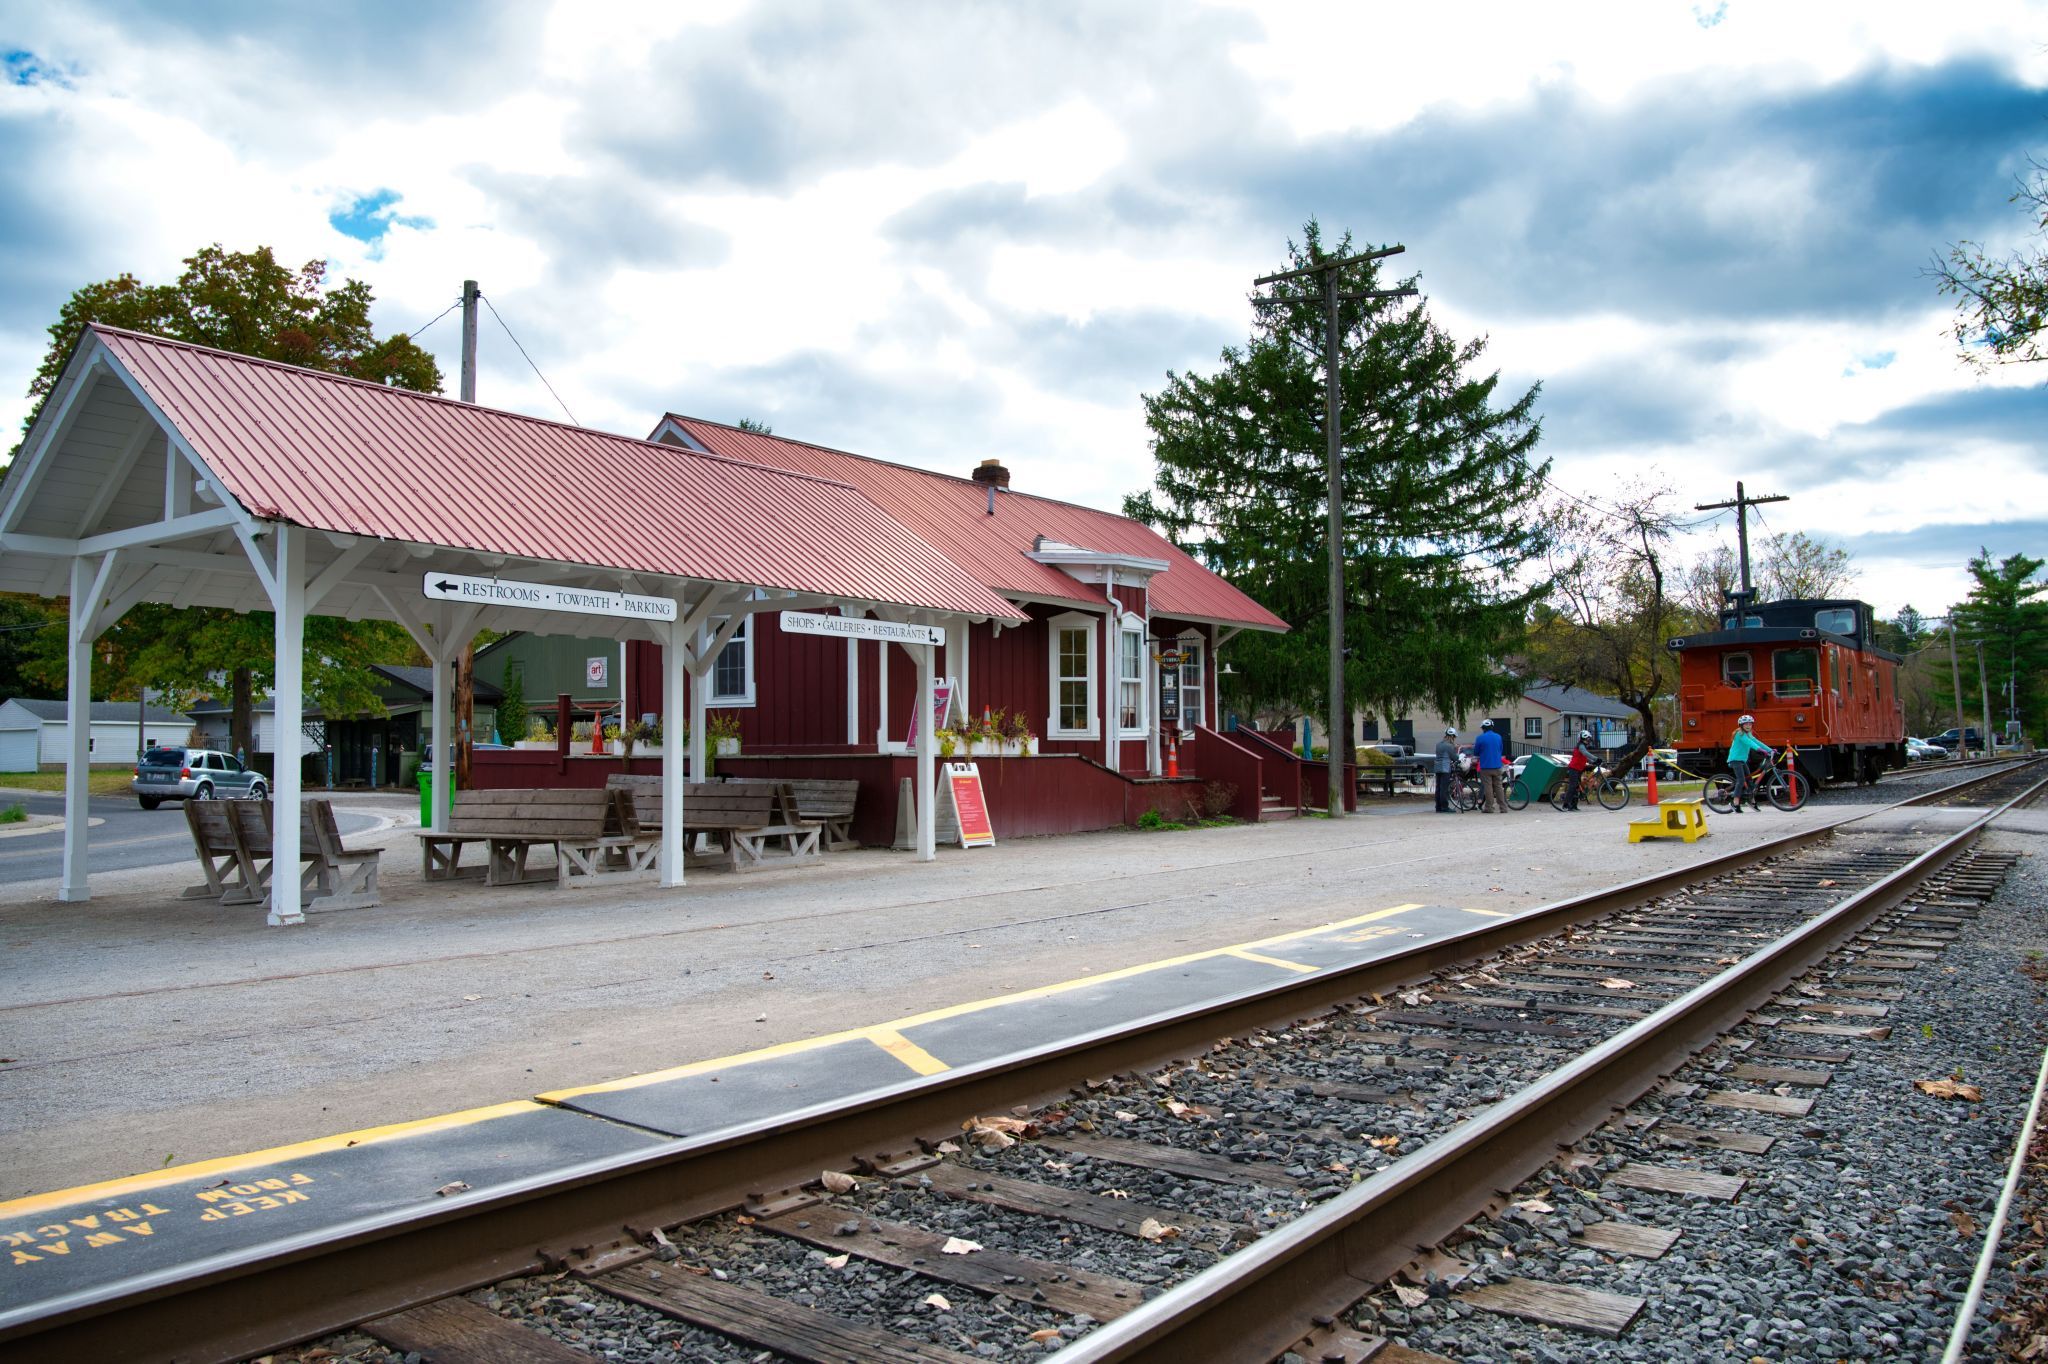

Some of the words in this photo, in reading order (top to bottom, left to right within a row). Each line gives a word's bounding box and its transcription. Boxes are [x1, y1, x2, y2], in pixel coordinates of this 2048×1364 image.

[463, 582, 540, 602] RESTROOMS
[556, 592, 610, 609] TOWPATH
[624, 600, 671, 615] PARKING
[787, 616, 815, 629] SHOPS
[822, 620, 866, 634] GALLERIES
[873, 625, 926, 639] RESTAURANTS
[591, 665, 601, 675] art
[195, 1173, 315, 1203] FROM
[199, 1190, 310, 1222] KEEP
[0, 1203, 170, 1247] TRACK
[10, 1221, 154, 1265] AWAY
